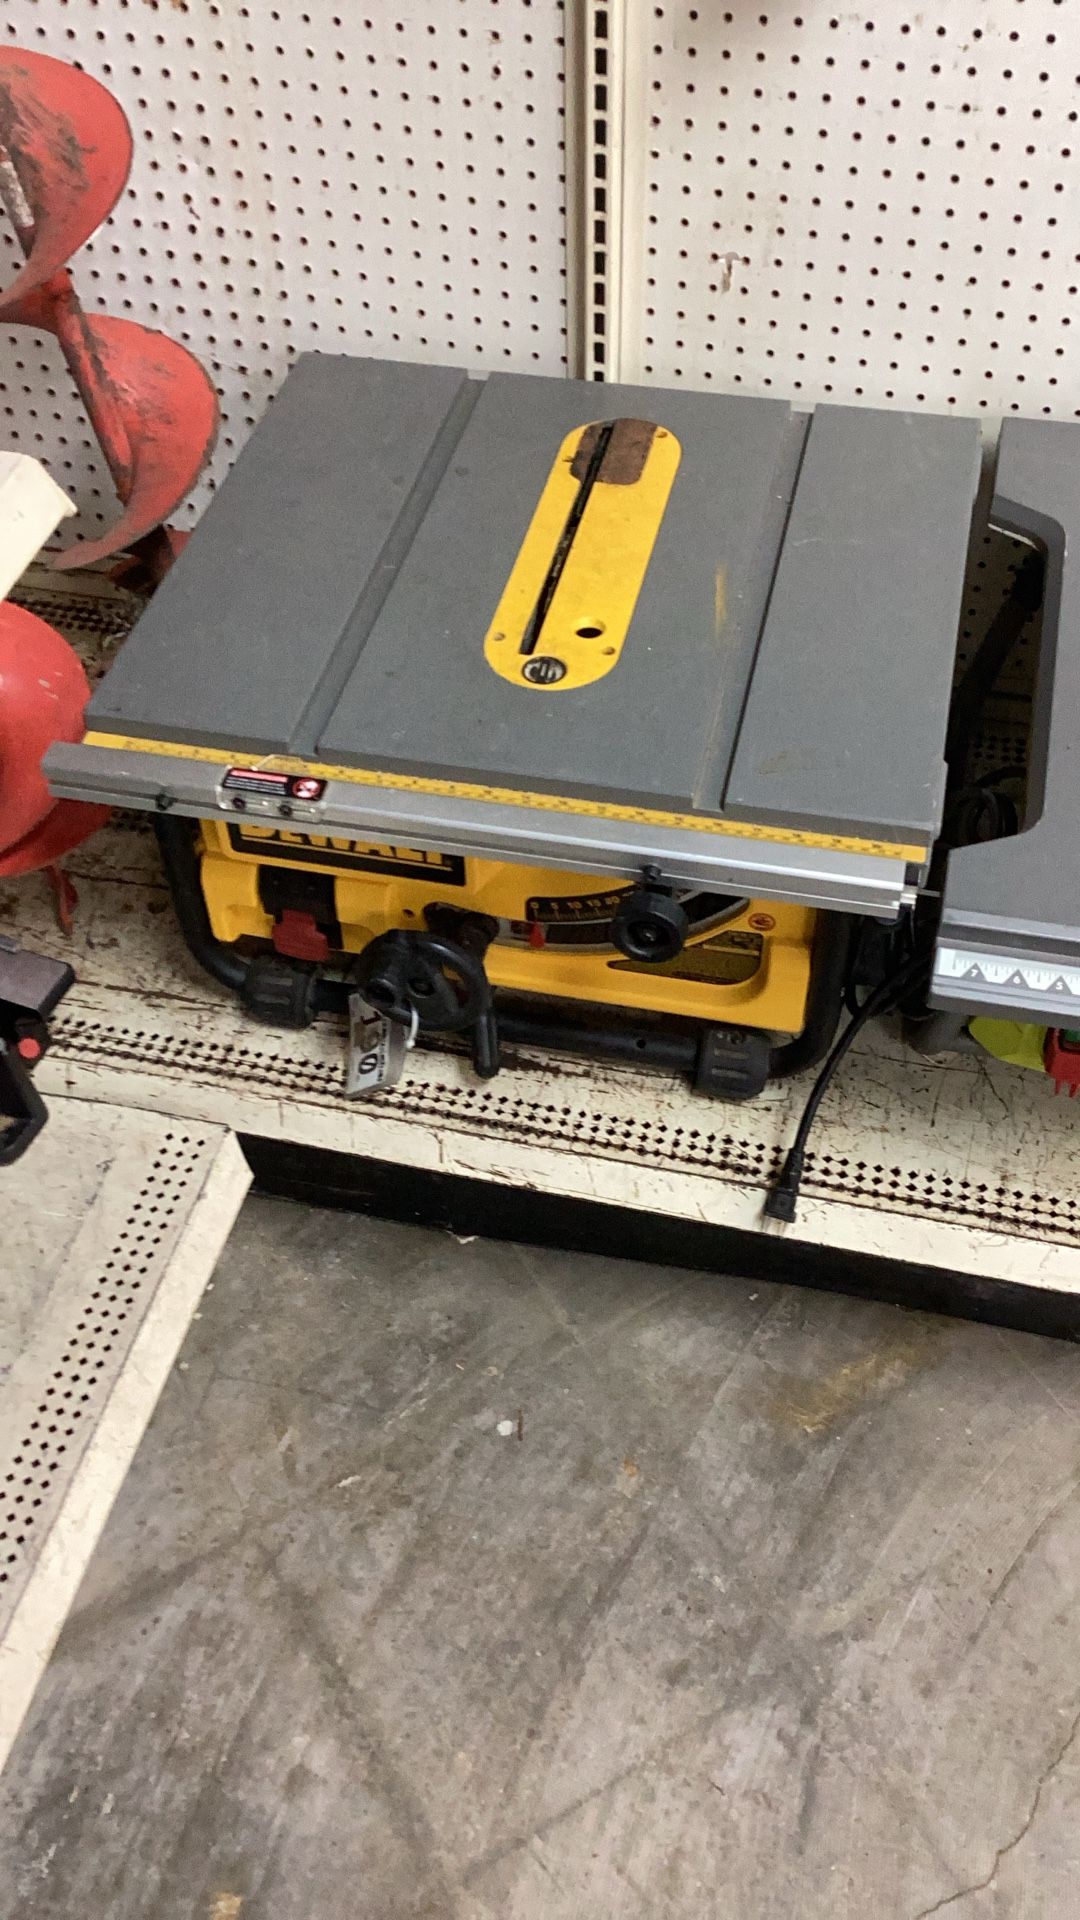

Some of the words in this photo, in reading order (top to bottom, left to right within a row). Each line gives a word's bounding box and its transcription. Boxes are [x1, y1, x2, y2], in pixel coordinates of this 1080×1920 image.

[970, 969, 979, 977] 7
[1013, 975, 1021, 984] 6
[1056, 982, 1064, 990] 5
